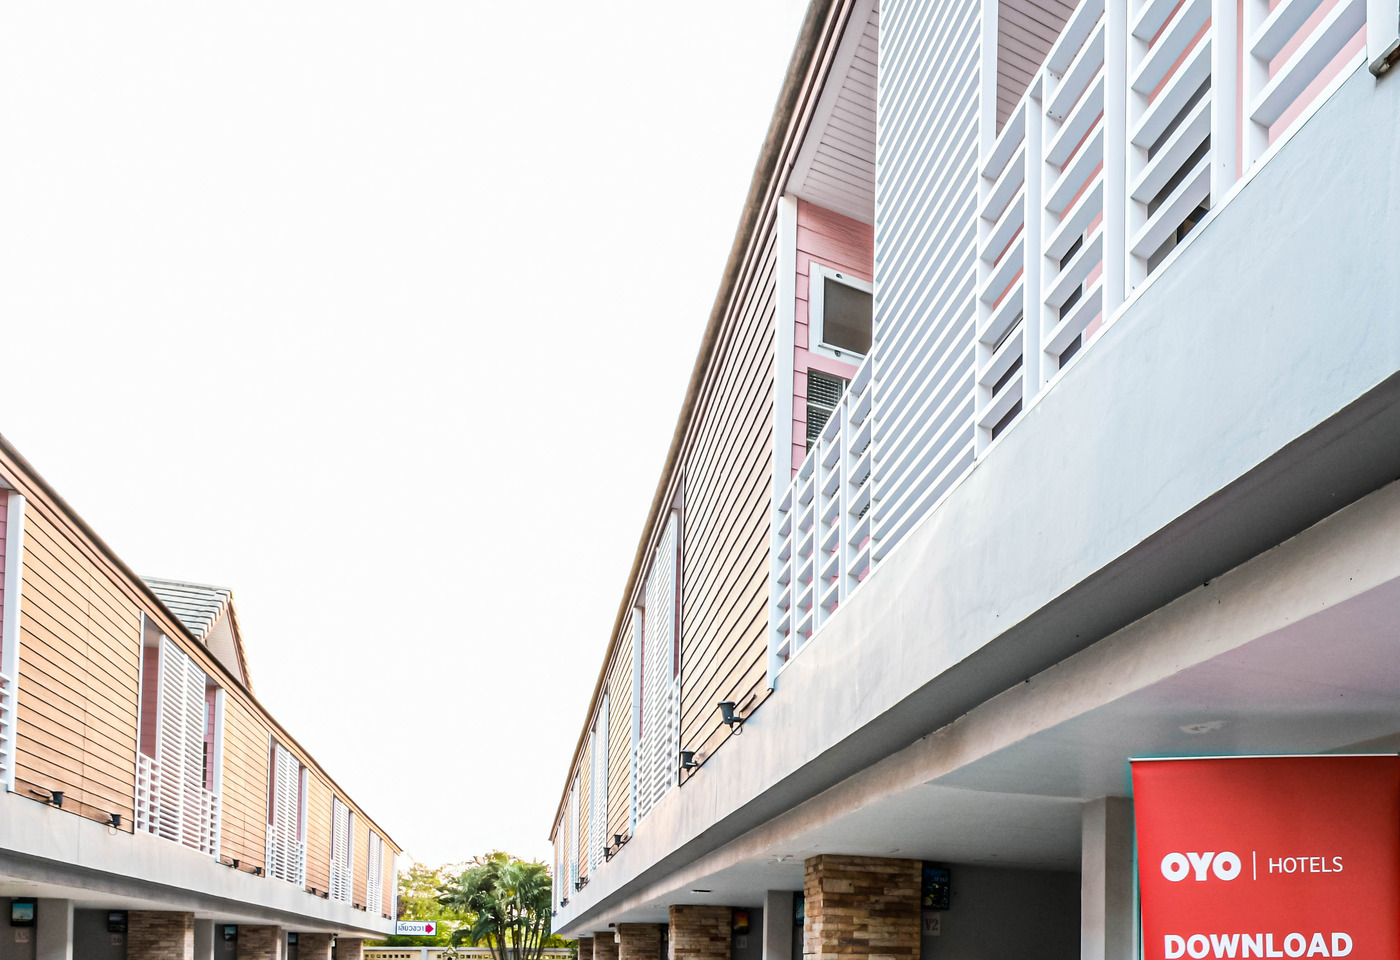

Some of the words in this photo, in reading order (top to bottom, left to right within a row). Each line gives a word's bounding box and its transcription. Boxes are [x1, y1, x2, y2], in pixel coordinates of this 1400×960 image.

[1160, 851, 1242, 882] OYO
[1269, 857, 1343, 873] HOTELS
[925, 918, 940, 931] V2
[1164, 932, 1353, 959] DOWNLOAD
